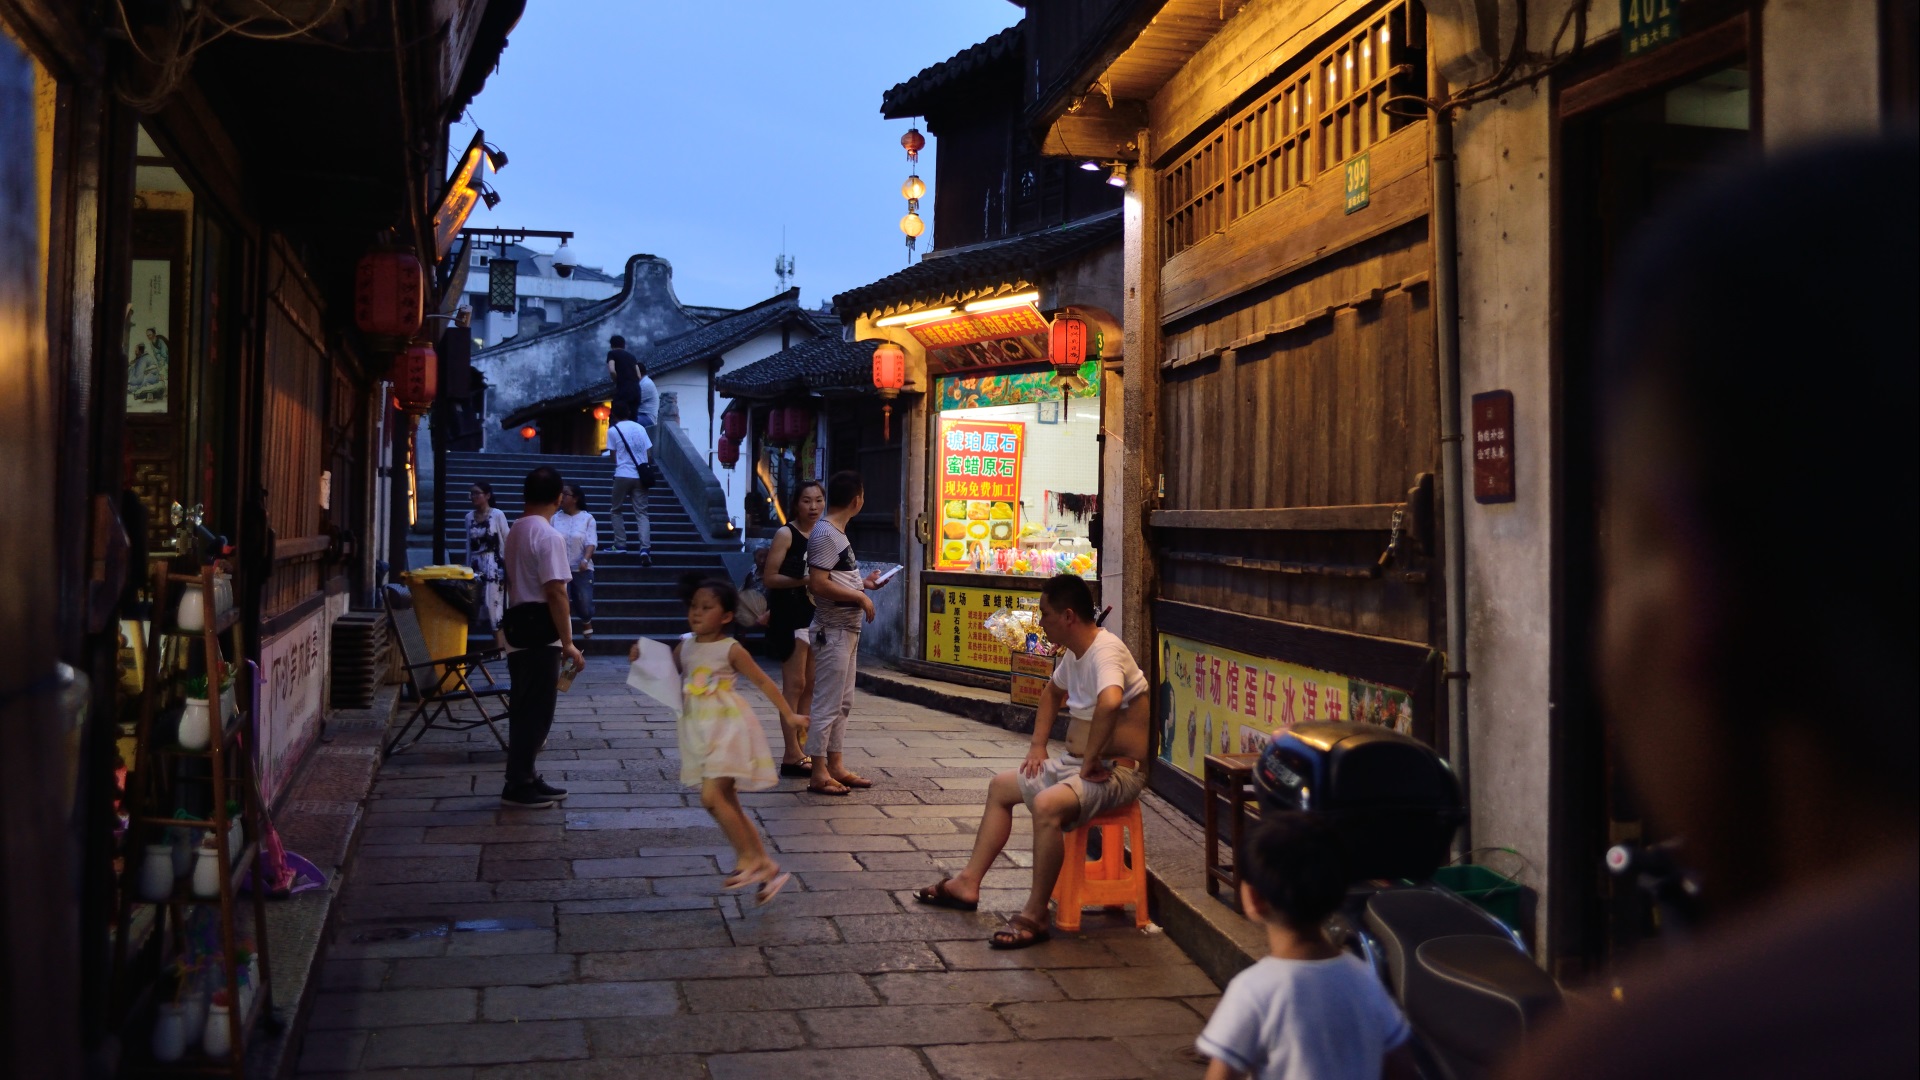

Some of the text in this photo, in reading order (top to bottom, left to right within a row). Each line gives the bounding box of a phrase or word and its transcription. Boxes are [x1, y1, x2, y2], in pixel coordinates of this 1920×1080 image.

[1628, 0, 1671, 29] 401
[1347, 158, 1366, 192] 399
[913, 309, 1044, 347] 蜜蜡原石专卖琥珀原石专卖
[946, 430, 1017, 453] 琥珀原石
[946, 456, 1016, 478] 蜜蜡原石
[944, 481, 1015, 498] 现场免费加工
[948, 591, 967, 606] 现场
[933, 619, 942, 658] 琥珀
[953, 607, 961, 662] 原石免费加工
